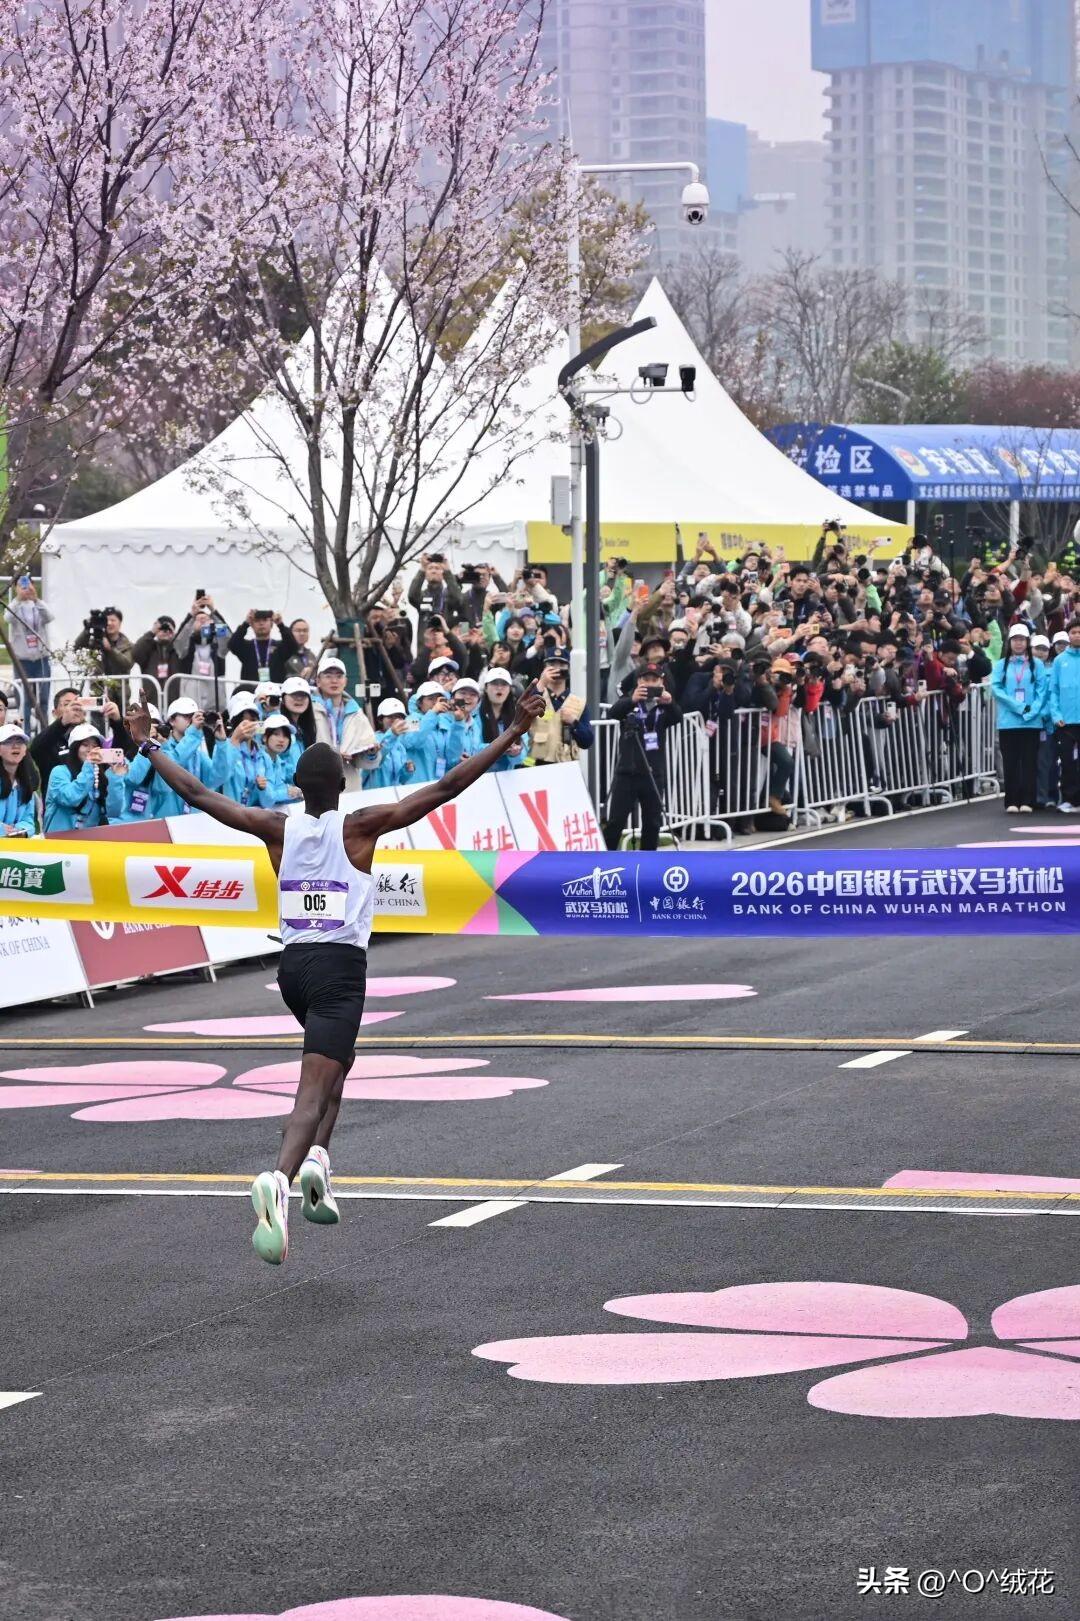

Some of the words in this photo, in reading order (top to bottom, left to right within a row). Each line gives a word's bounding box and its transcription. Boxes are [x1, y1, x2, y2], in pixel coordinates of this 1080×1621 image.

[731, 866, 1064, 897] 2026中国银行武汉马拉松
[190, 880, 244, 899] 特步
[303, 893, 326, 911] 005
[388, 898, 420, 907] CHINA
[565, 901, 629, 914] 武汉马拉松
[733, 903, 783, 914] BANK
[790, 903, 813, 914] OF
[820, 903, 876, 914] CHINA
[884, 902, 952, 914] WUHAN
[959, 901, 1066, 913] MARATHON
